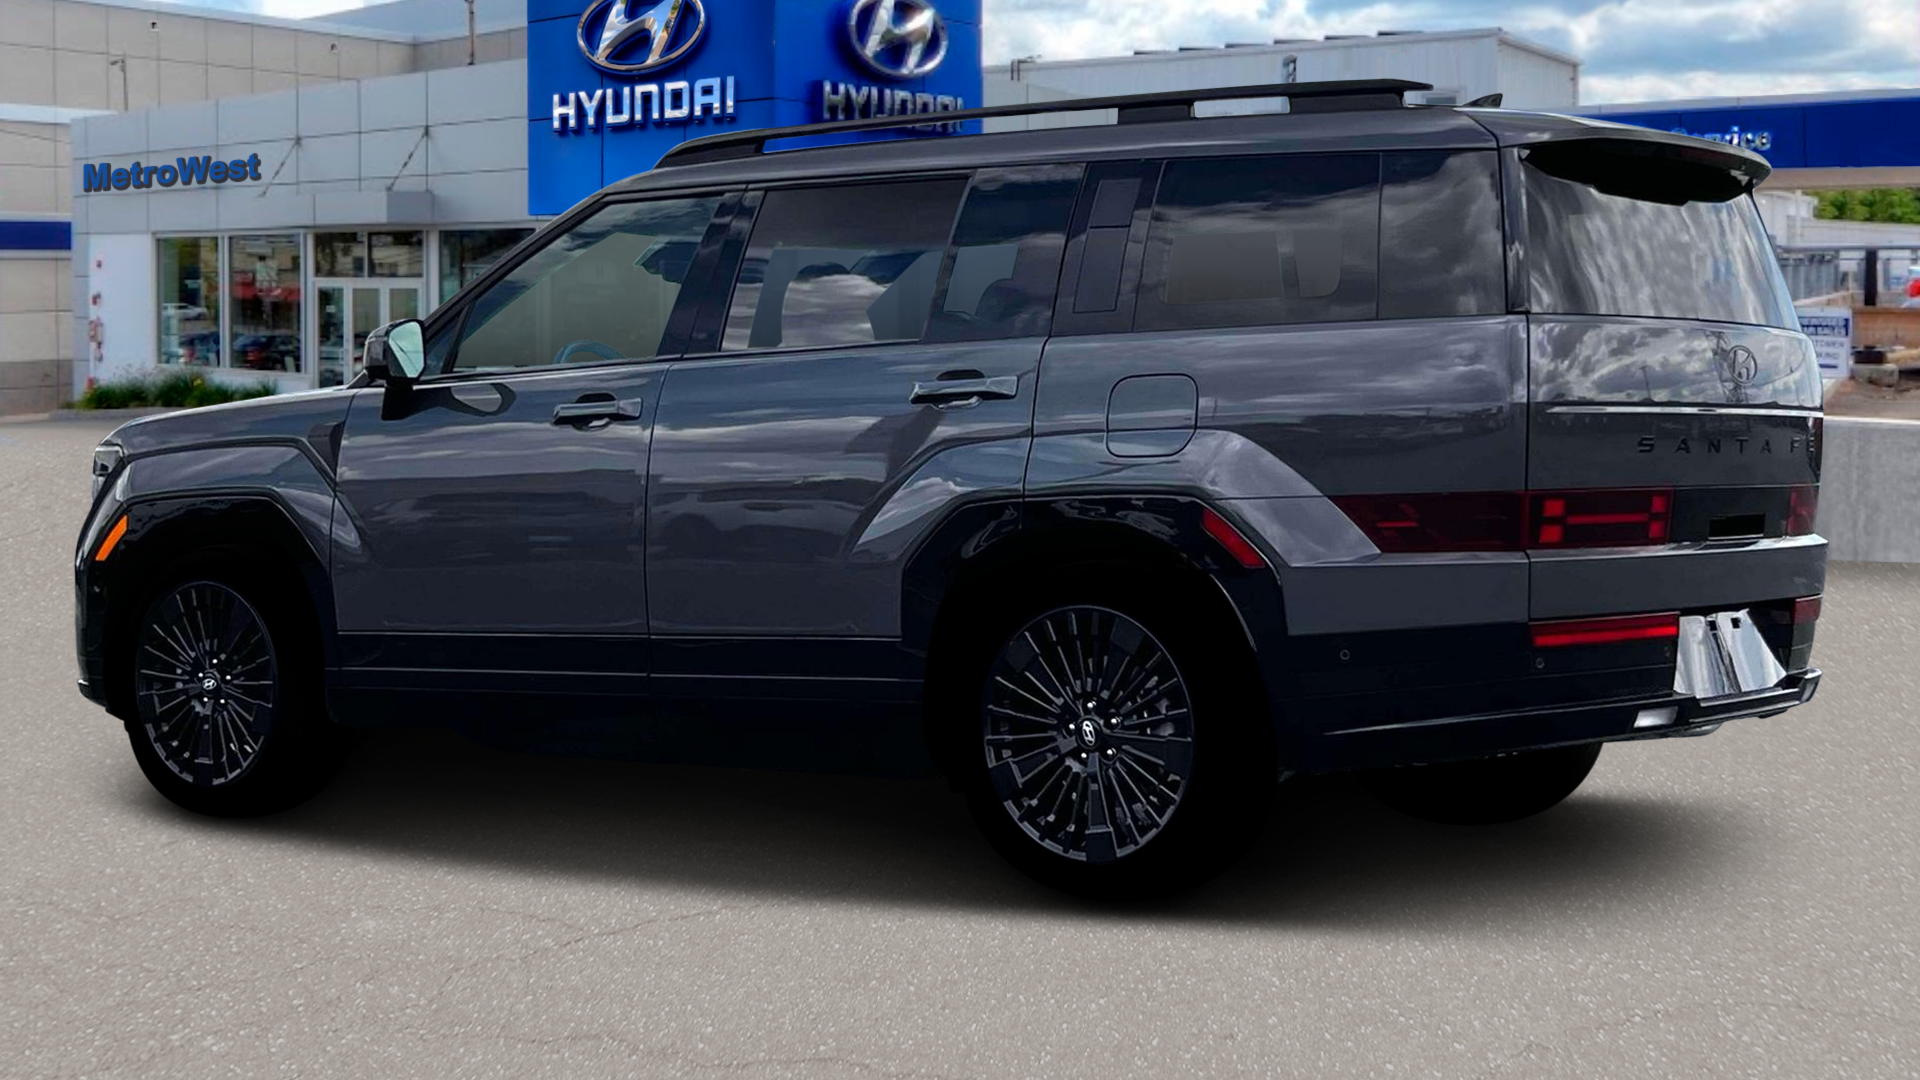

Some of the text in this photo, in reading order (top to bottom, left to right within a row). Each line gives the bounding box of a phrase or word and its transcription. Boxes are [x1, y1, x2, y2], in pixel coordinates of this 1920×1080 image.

[552, 75, 735, 130] HYUNDAI
[822, 80, 965, 133] HYUNDAI
[1670, 125, 1772, 151] vice
[83, 153, 262, 193] MetroWest
[1636, 434, 1816, 455] SANTA FE
